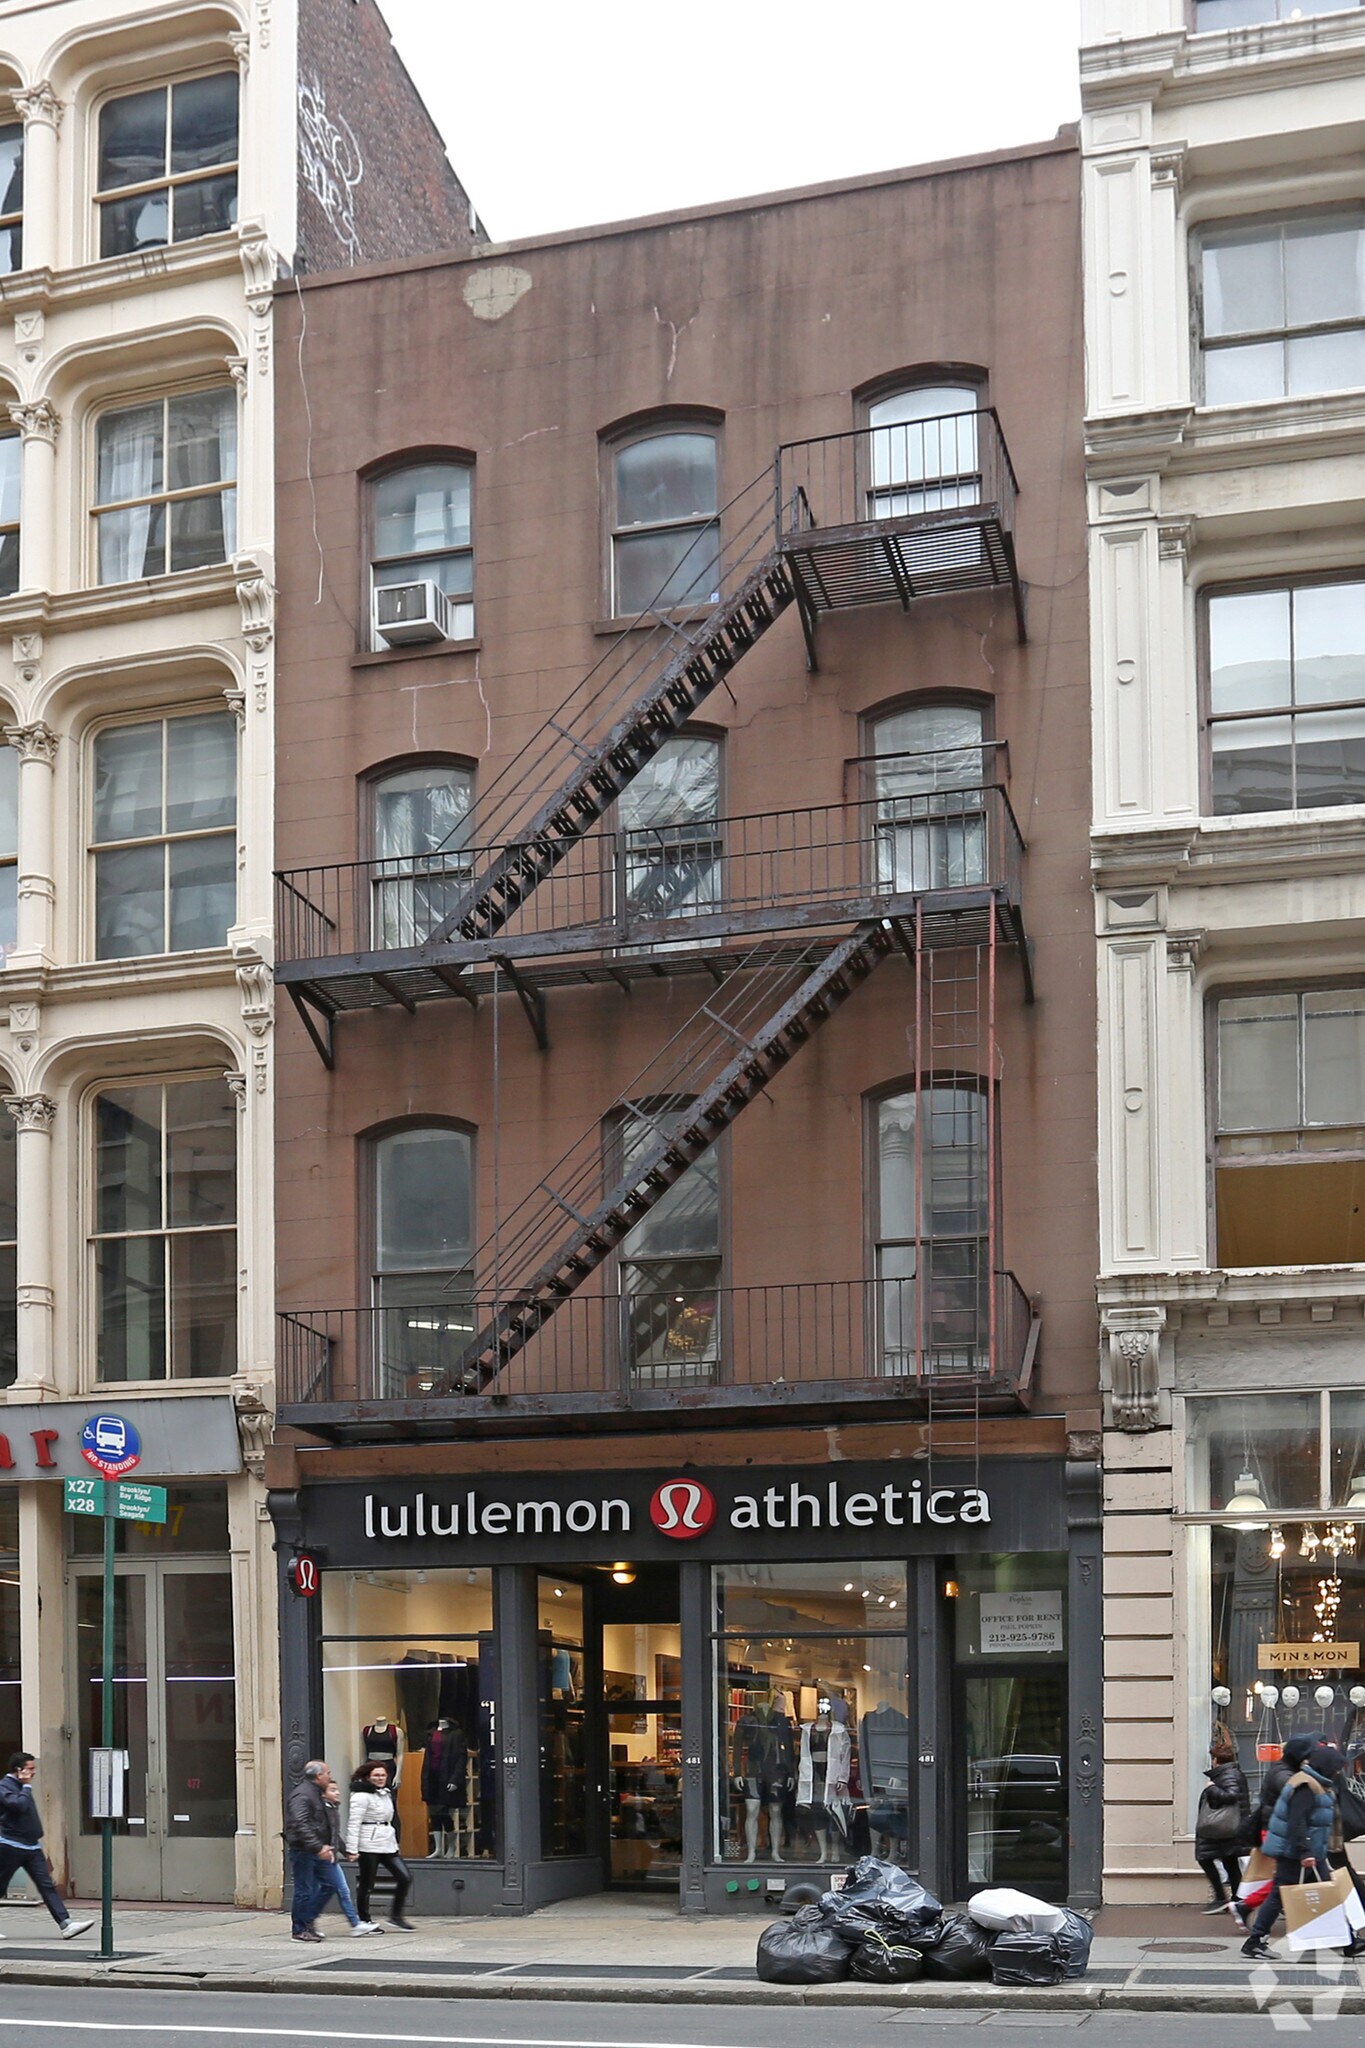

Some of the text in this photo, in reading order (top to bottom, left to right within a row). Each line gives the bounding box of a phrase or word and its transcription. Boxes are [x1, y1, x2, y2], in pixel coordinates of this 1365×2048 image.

[86, 1451, 136, 1471] NO STANDING
[68, 1480, 95, 1494] X27
[120, 1492, 152, 1503] Bay Ridge
[68, 1498, 95, 1512] X28
[365, 1479, 992, 1538] lululemon athletica
[119, 1510, 145, 1519] Seagate
[981, 1613, 1061, 1623] OFFICE FOR RENT
[988, 1632, 1055, 1642] 212-925-9786
[1270, 1651, 1348, 1661] MIN & MON
[503, 1756, 517, 1764] 481
[918, 1755, 935, 1763] 481
